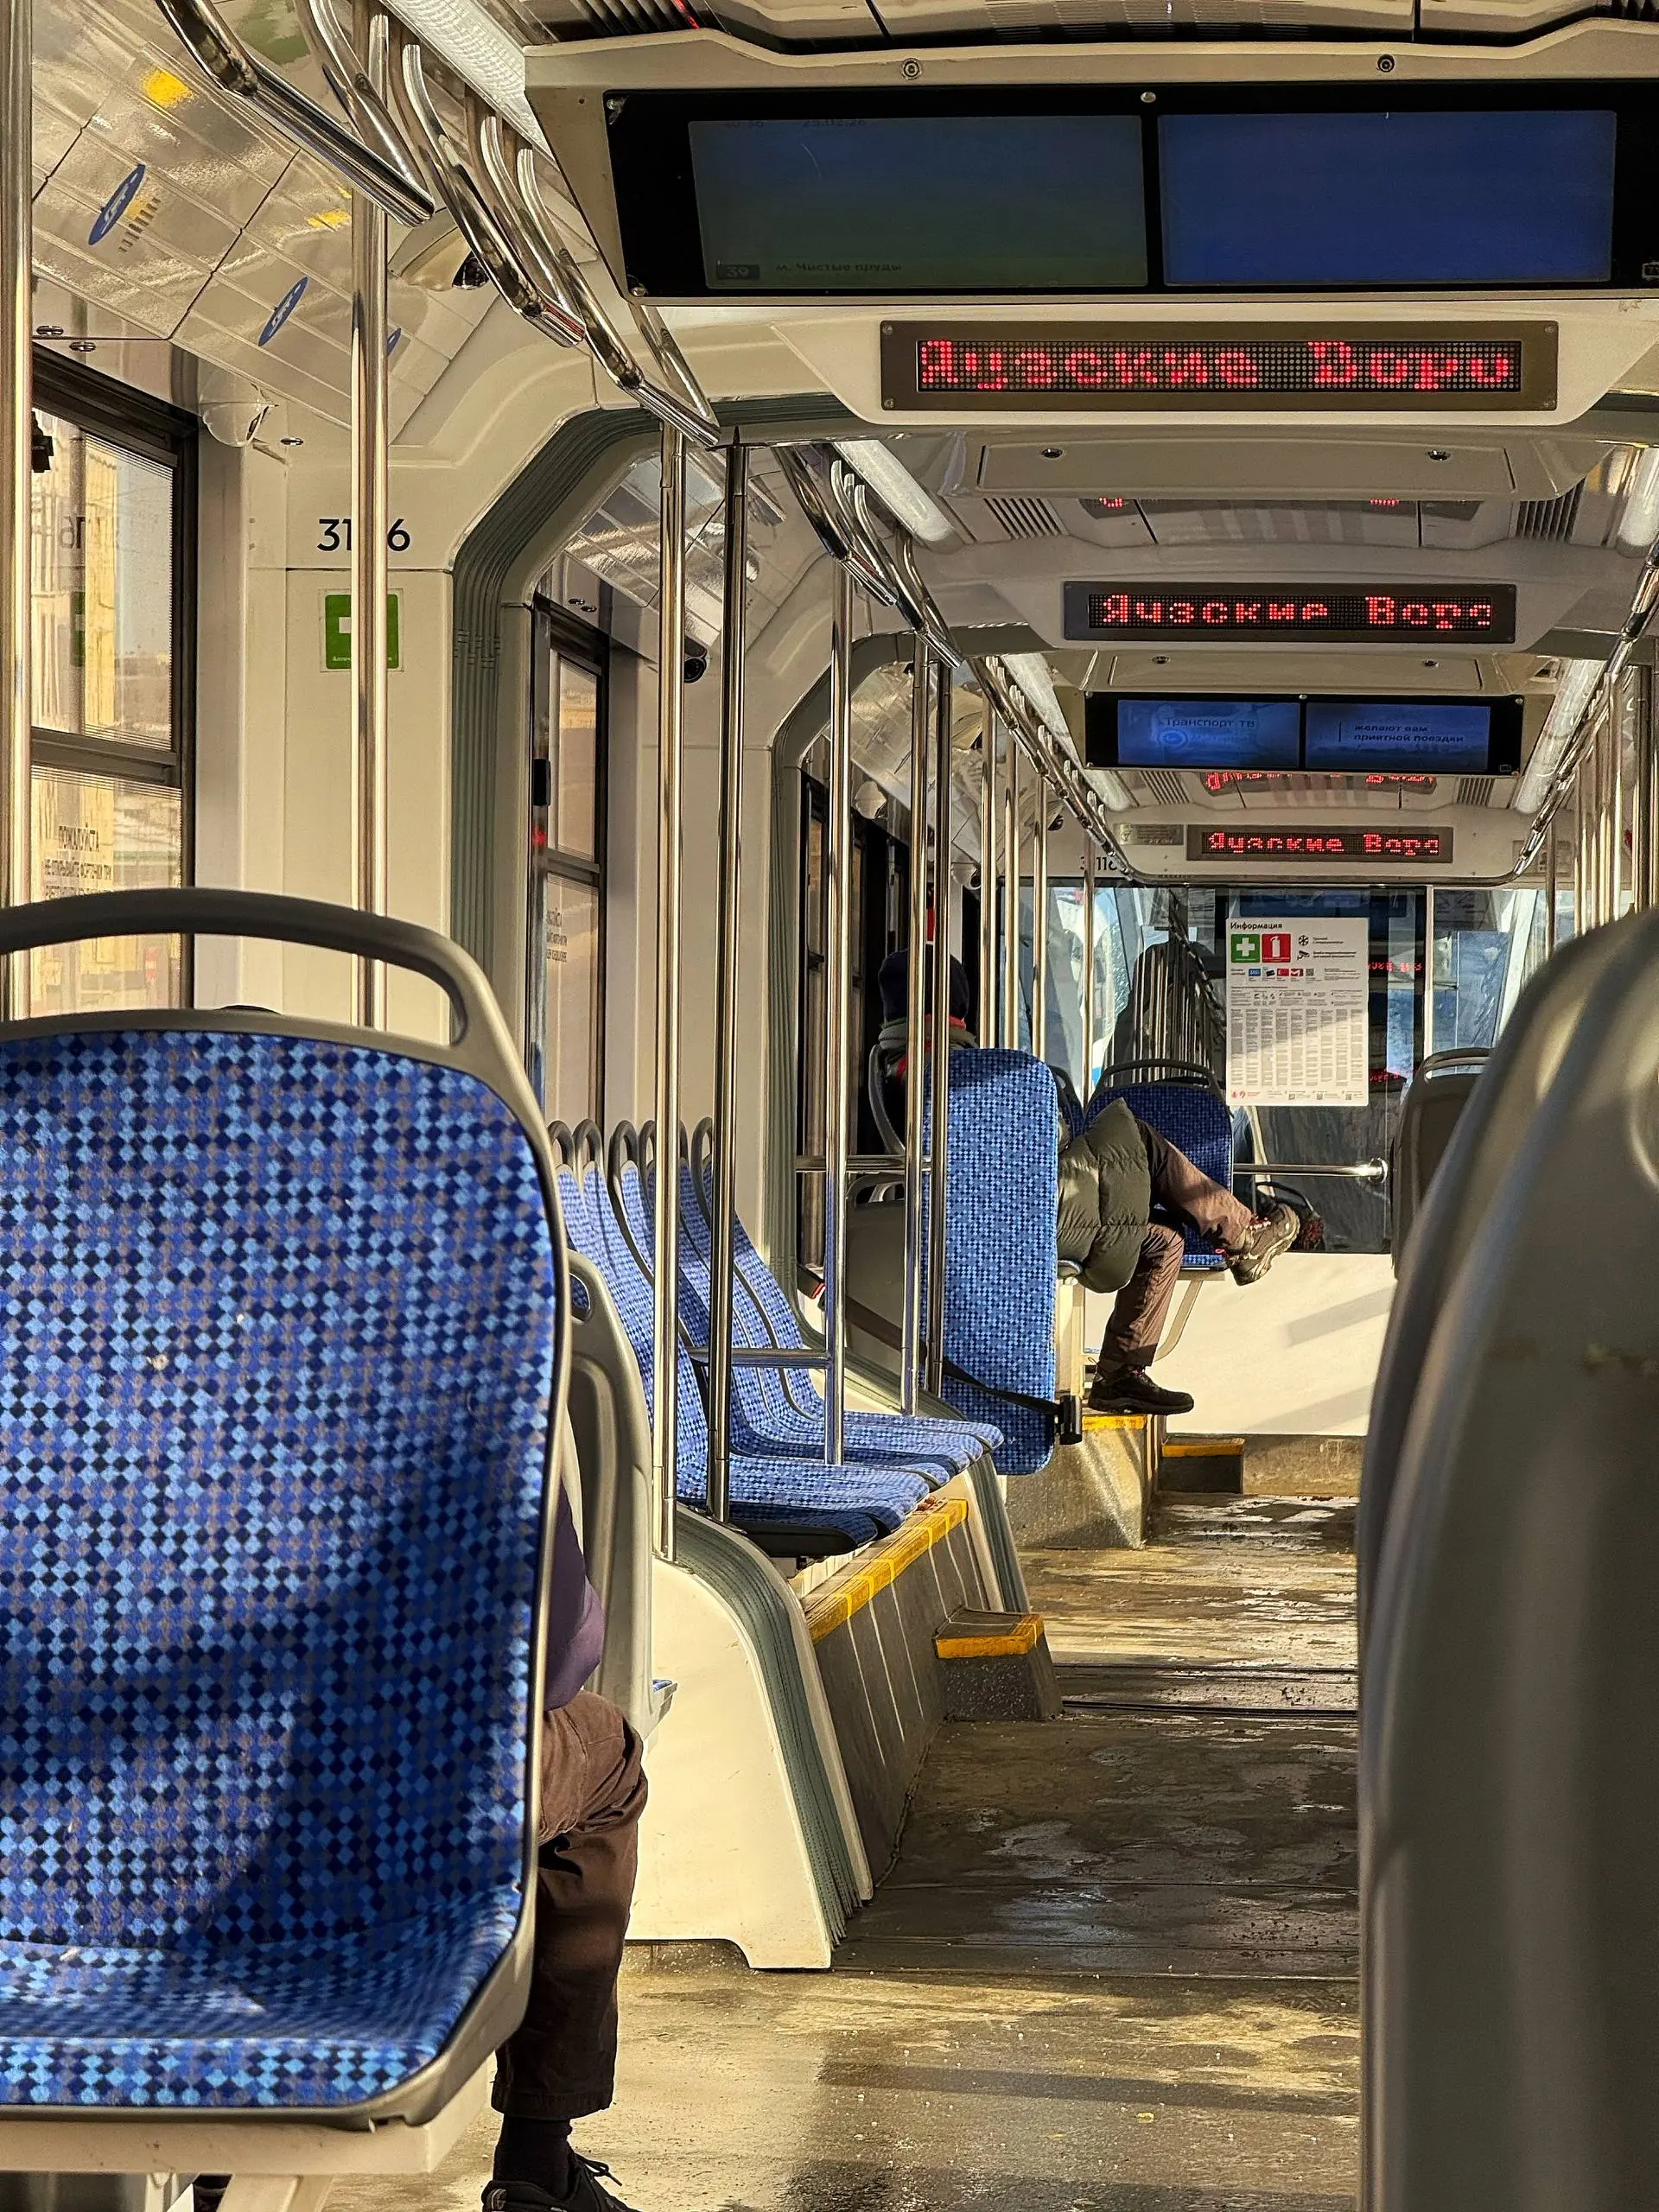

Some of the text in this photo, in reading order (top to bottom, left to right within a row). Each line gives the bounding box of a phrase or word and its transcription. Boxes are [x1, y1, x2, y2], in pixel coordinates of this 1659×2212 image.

[795, 262, 851, 271] Чистые
[1165, 717, 1235, 728] Транспорт
[1354, 724, 1402, 733] желают
[1354, 733, 1464, 743] приятной поездки
[1230, 921, 1283, 931] Информация
